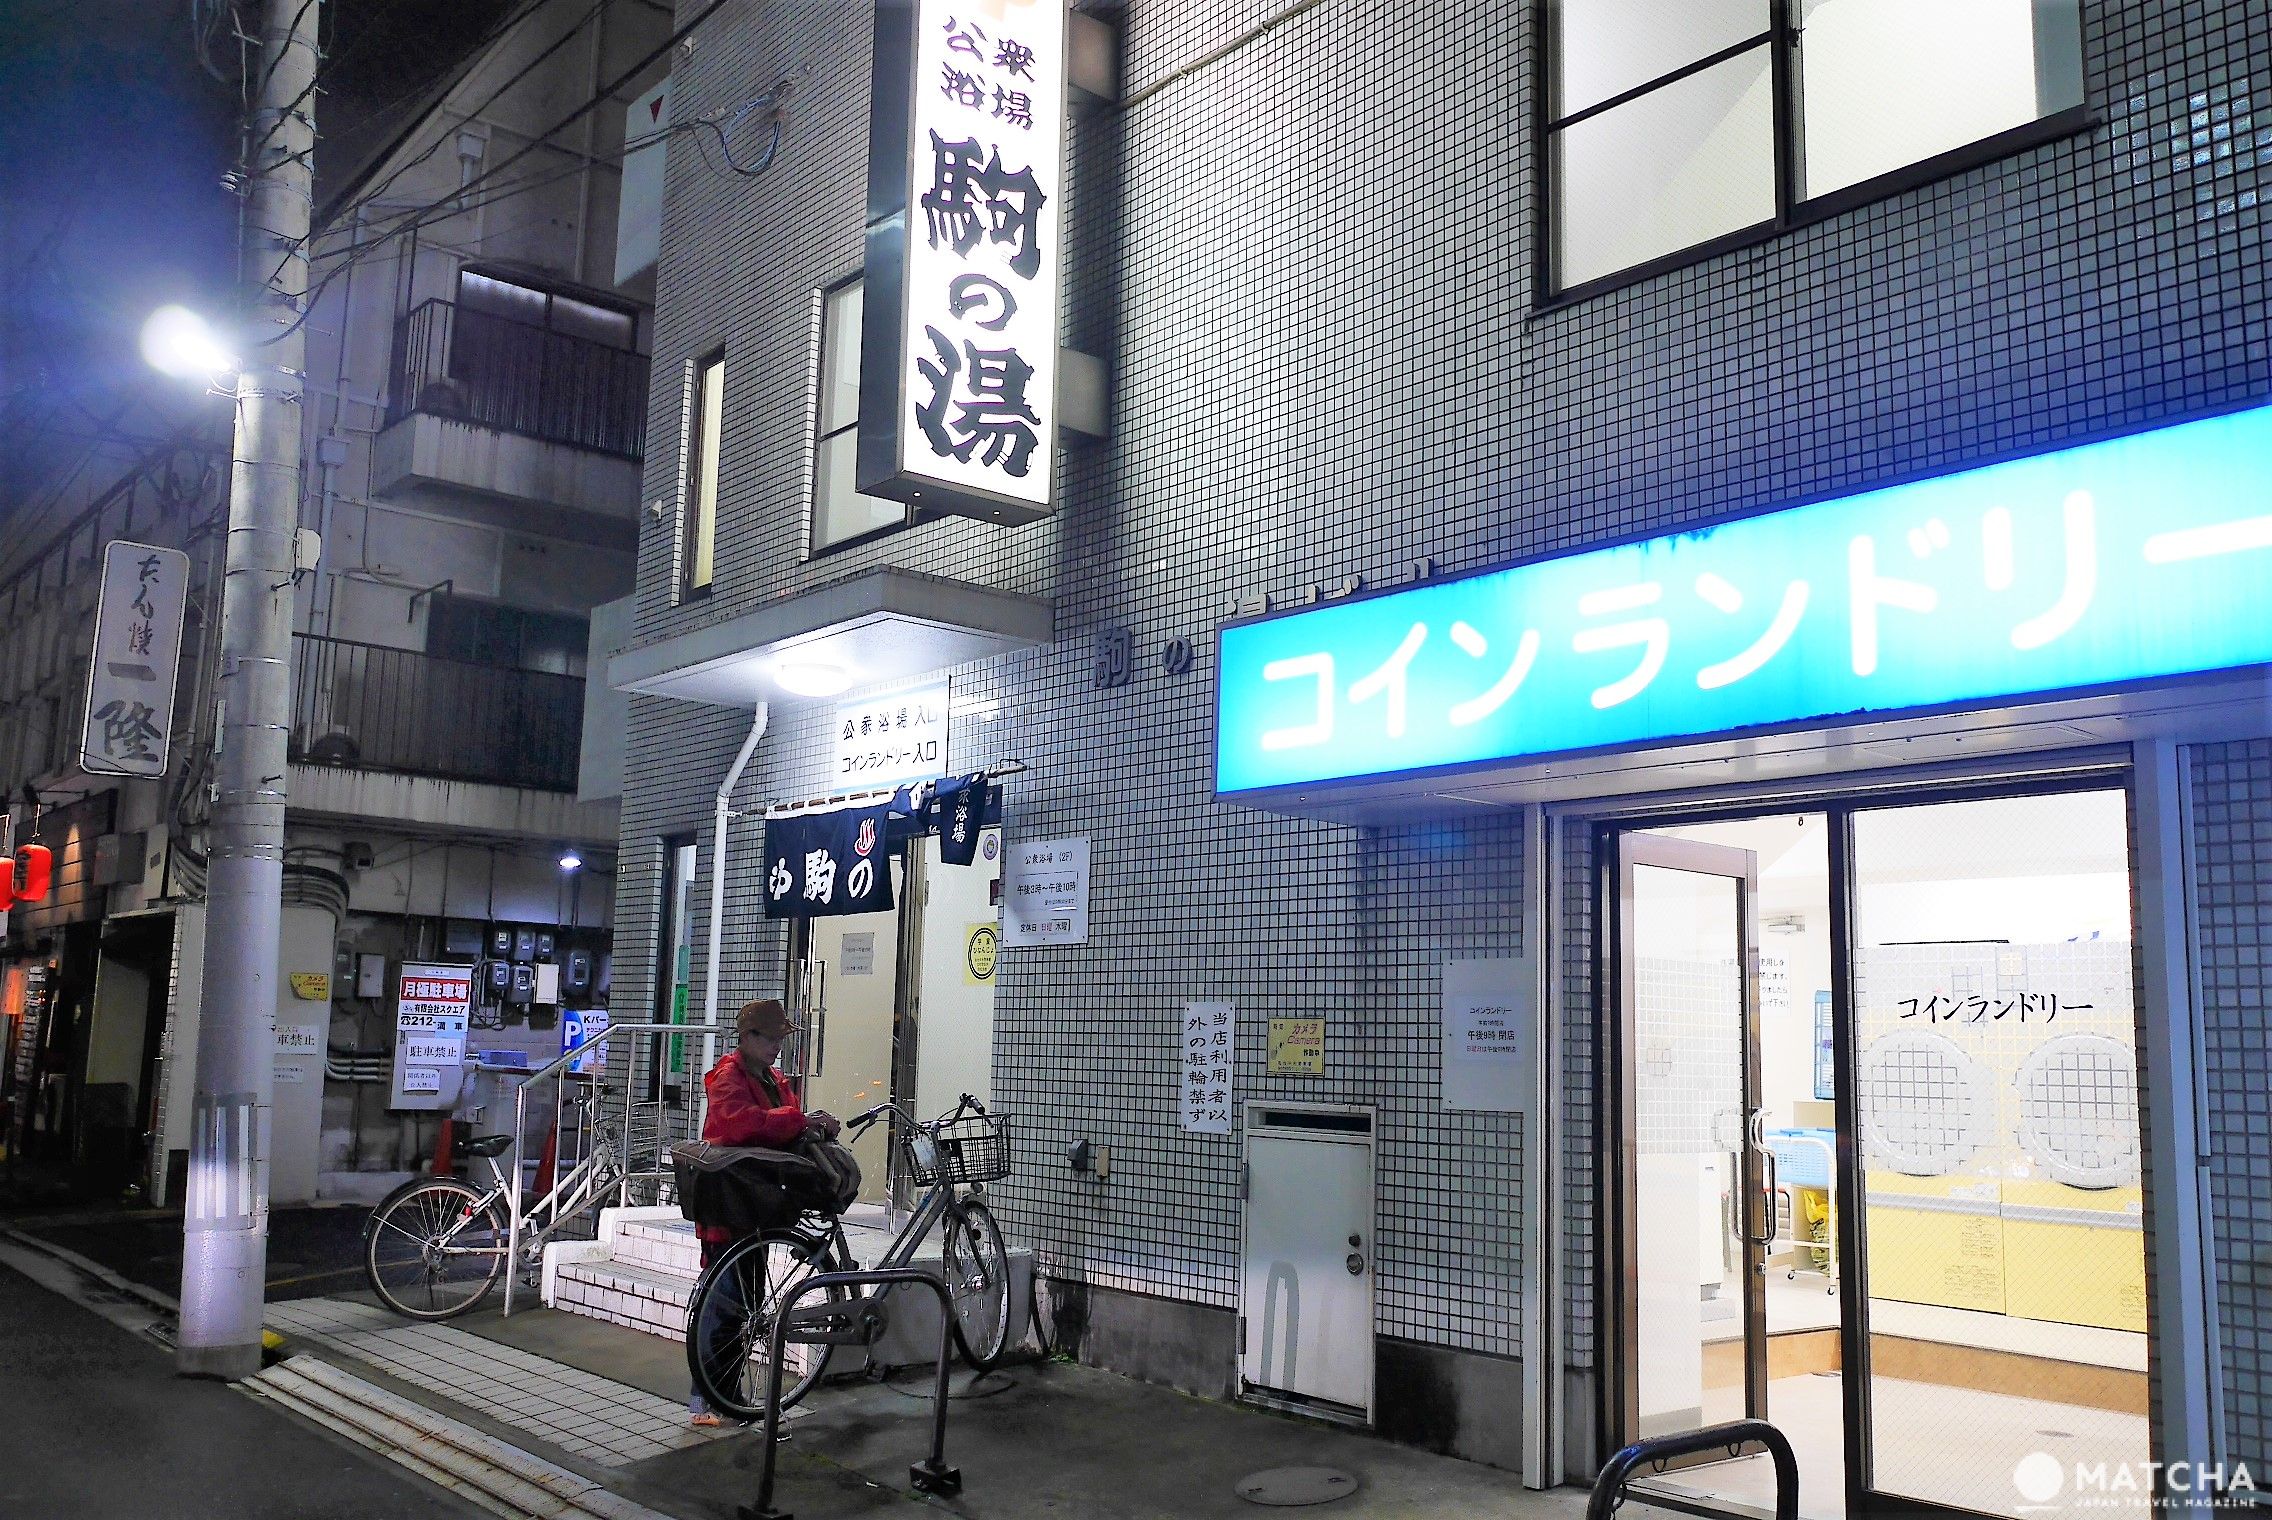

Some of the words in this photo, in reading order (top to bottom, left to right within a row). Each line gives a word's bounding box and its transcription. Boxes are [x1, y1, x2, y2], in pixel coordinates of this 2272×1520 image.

[915, 128, 1047, 478] 駒の湯
[1262, 489, 2272, 749] コインランドリー
[842, 740, 936, 773] コインランドリー入口
[1025, 852, 1053, 865] 公衆浴場
[403, 981, 467, 1000] 月極駐車場
[1470, 1006, 1512, 1015] コインランドリー
[1898, 992, 2094, 1024] コインランドリー
[1287, 1035, 1321, 1045] Camera
[1291, 1023, 1318, 1035] カメラ
[409, 1045, 457, 1058] 駐車禁止
[1187, 1016, 1208, 1122] 外の駐輪禁ず
[1208, 1012, 1228, 1122] 当店利用者以
